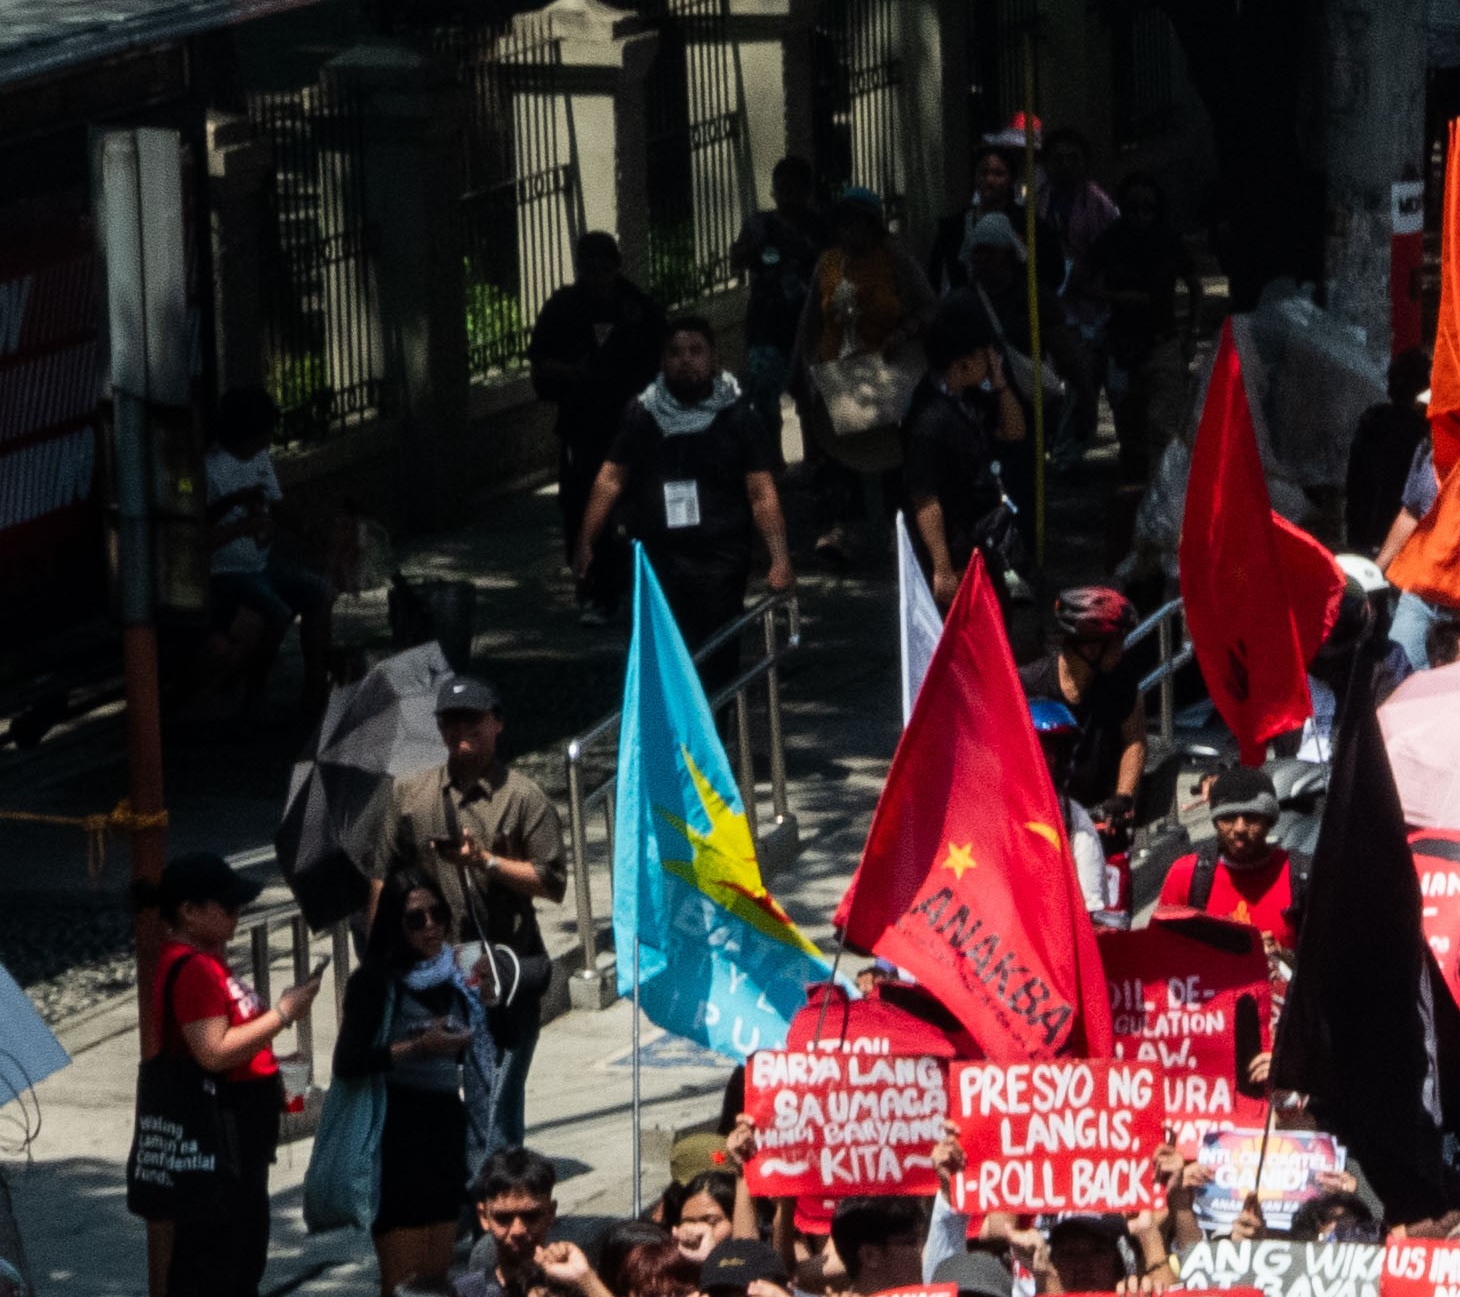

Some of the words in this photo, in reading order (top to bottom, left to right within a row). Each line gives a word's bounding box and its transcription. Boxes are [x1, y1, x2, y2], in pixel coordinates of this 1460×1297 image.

[752, 1055, 842, 1088] BARYA
[848, 1054, 942, 1090] LANG
[959, 1064, 1094, 1114] PRESYO
[1108, 1064, 1153, 1107] NG
[773, 1089, 818, 1128] SA
[820, 1088, 947, 1121] UMAGA
[820, 1145, 903, 1186] KITA
[1385, 1247, 1428, 1278] US
